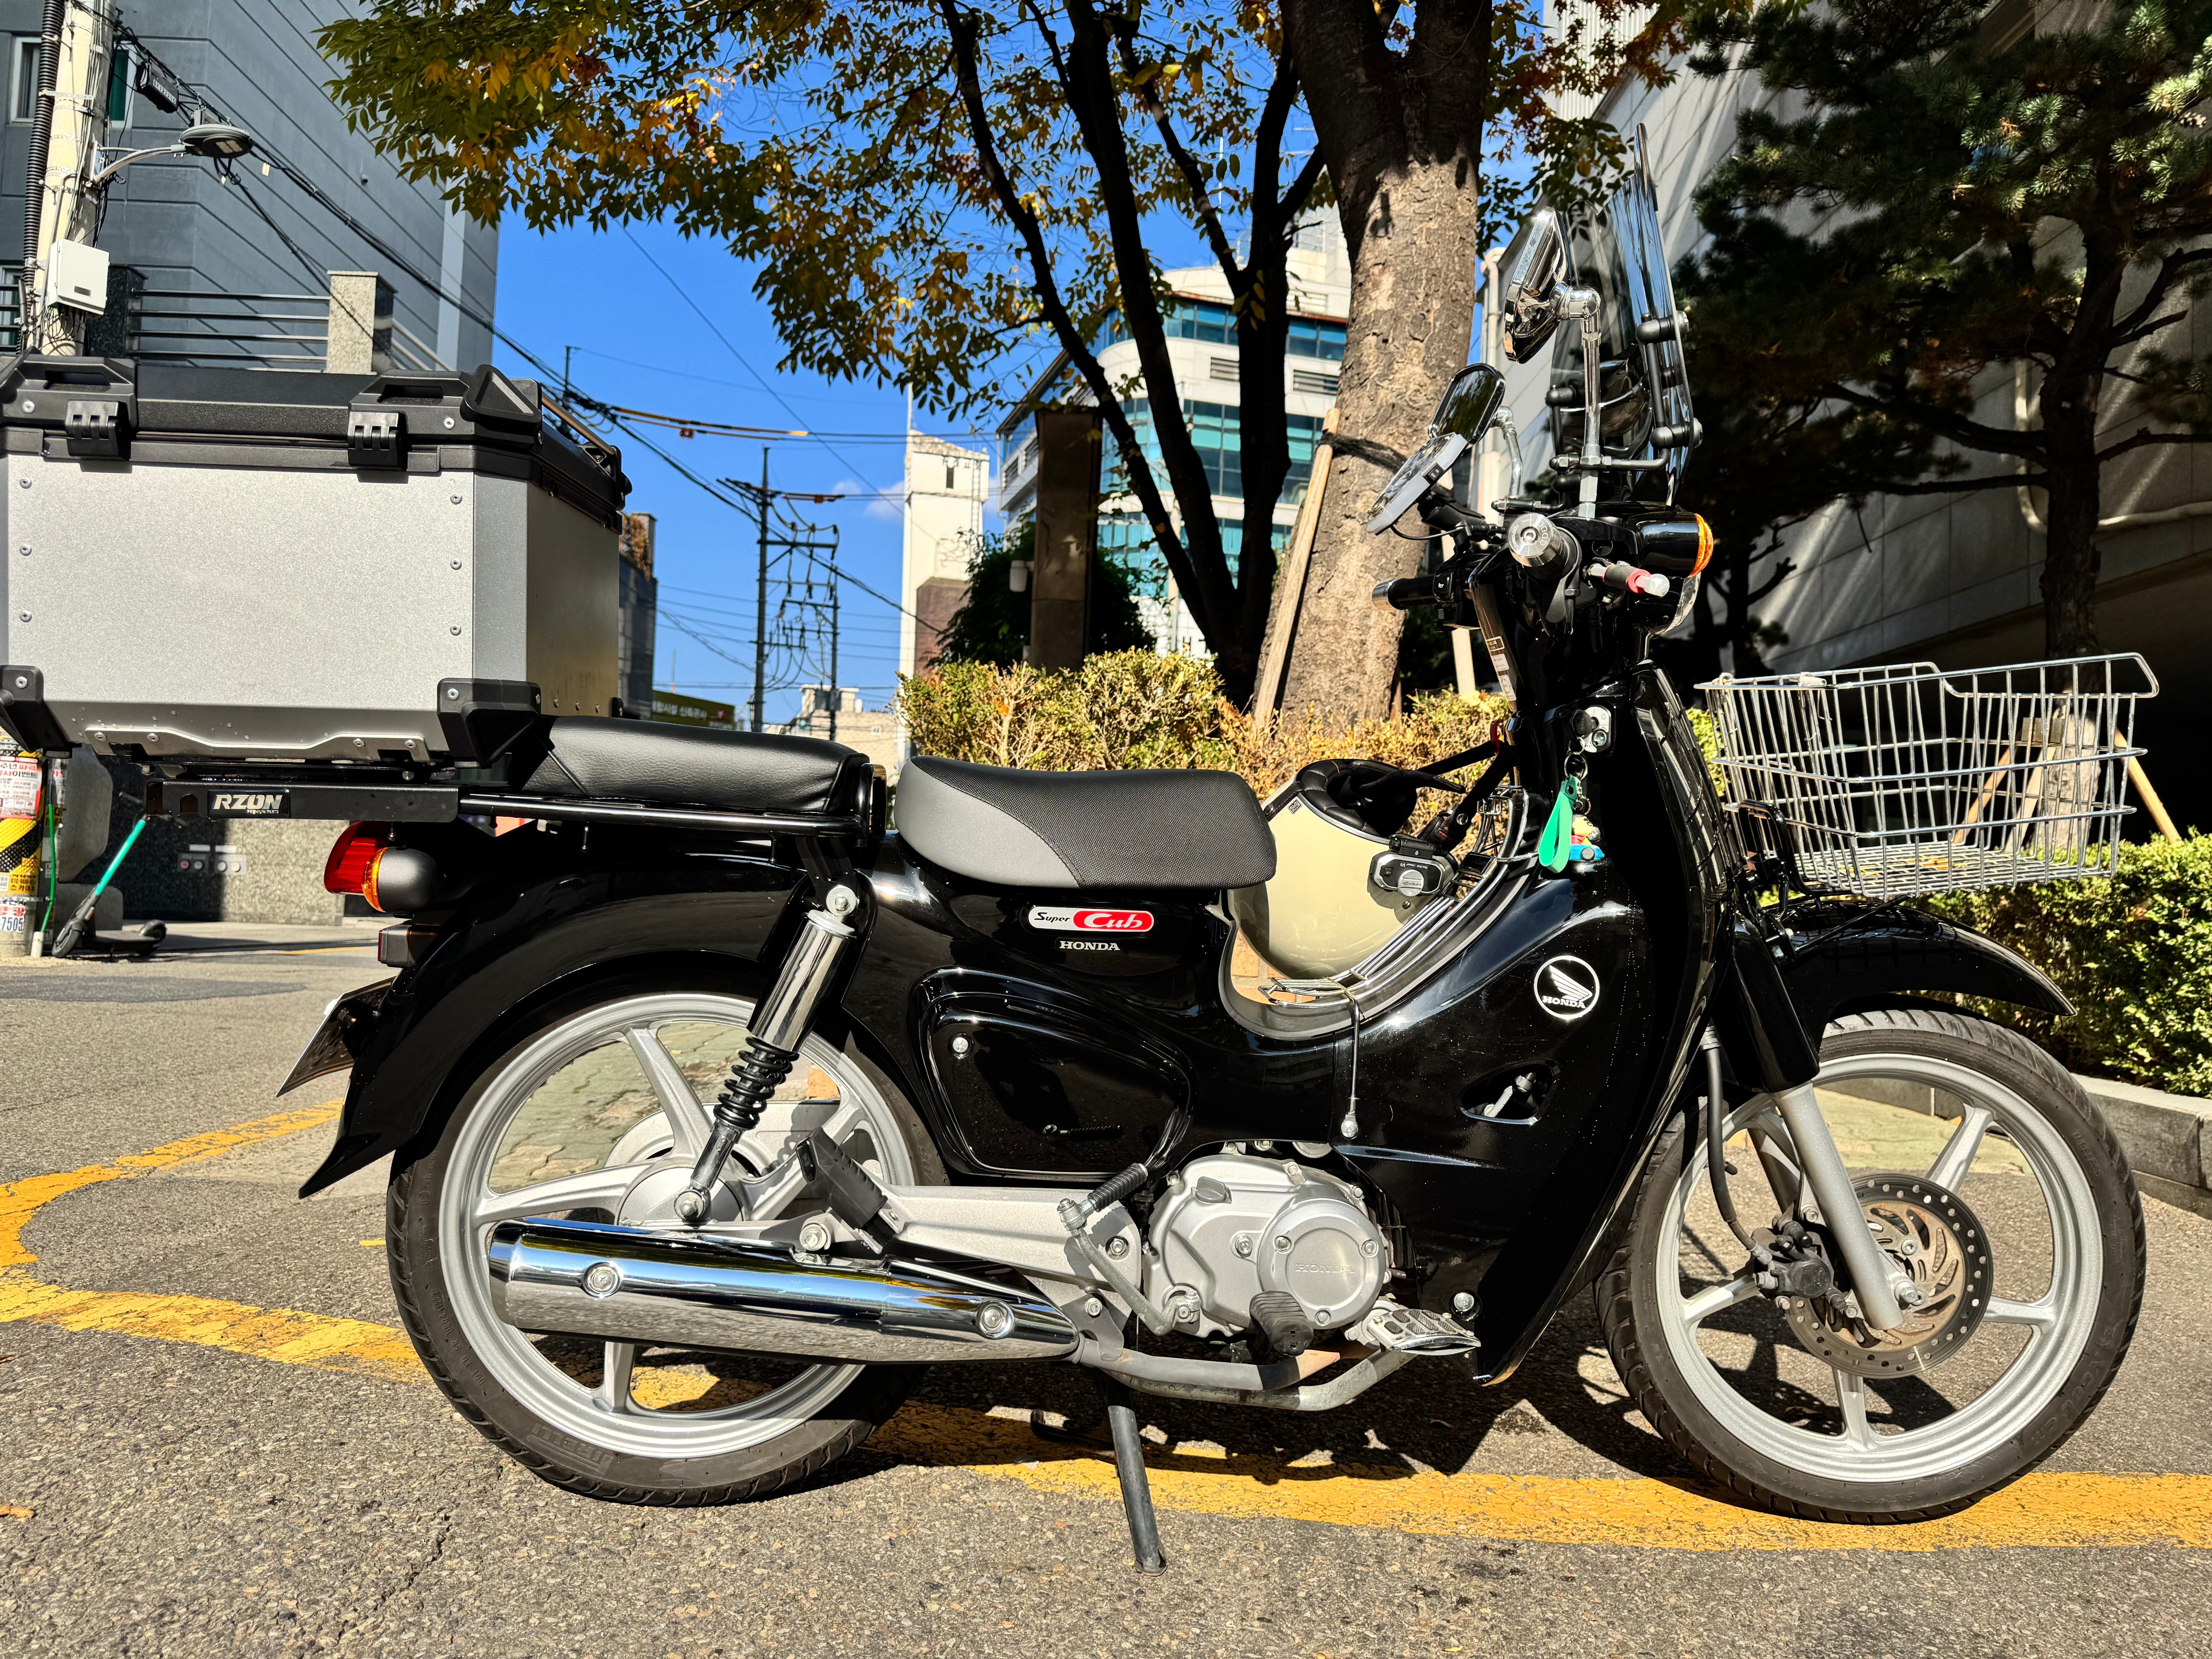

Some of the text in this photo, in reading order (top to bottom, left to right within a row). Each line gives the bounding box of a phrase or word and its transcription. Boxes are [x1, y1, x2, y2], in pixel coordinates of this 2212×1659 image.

[213, 795, 283, 809] RZON
[1034, 912, 1143, 928] Super Cub
[1059, 941, 1120, 950] HONDA
[1542, 995, 1586, 1009] HONDA
[1295, 1264, 1357, 1273] HONDA
[469, 1368, 487, 1387] DOT
[526, 1422, 614, 1475] PIRELLI
